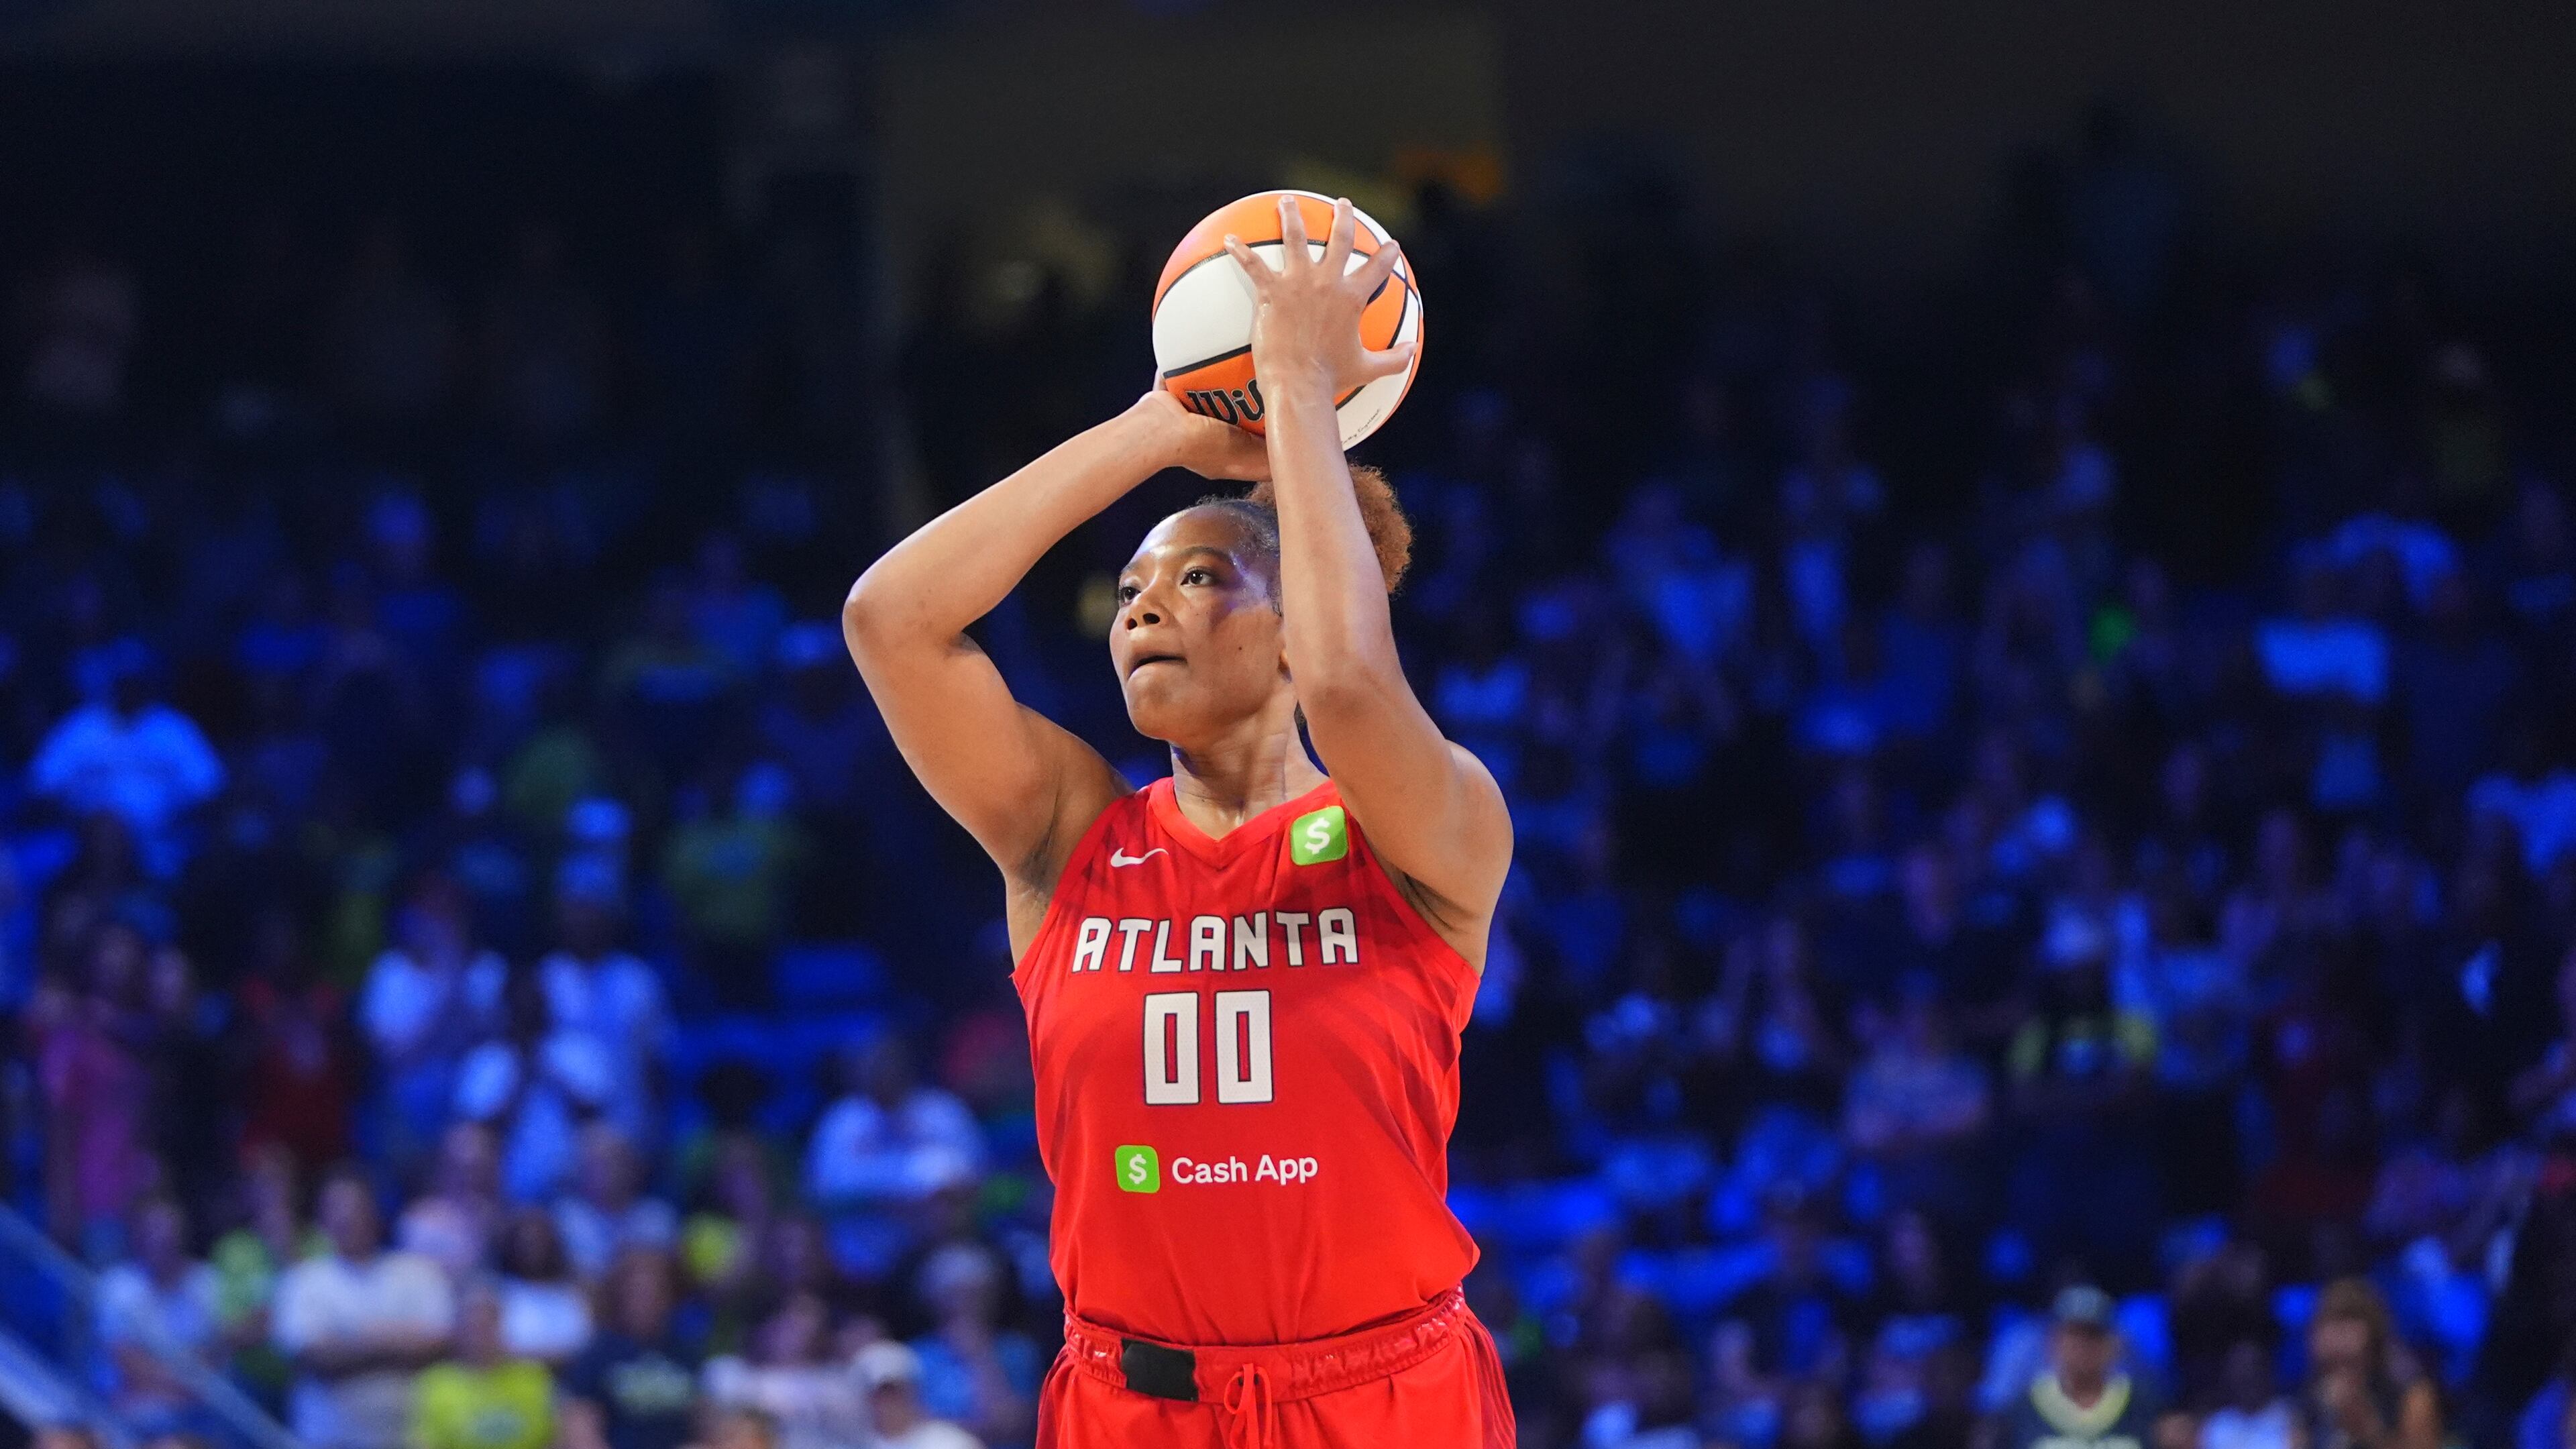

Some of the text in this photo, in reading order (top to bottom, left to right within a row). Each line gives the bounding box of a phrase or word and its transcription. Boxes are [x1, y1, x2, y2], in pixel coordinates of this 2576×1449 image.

[1072, 907, 1360, 973] ATLANTA
[1143, 988, 1274, 1106] 00
[1172, 1156, 1248, 1184] Cash
[1254, 1154, 1319, 1186] App
